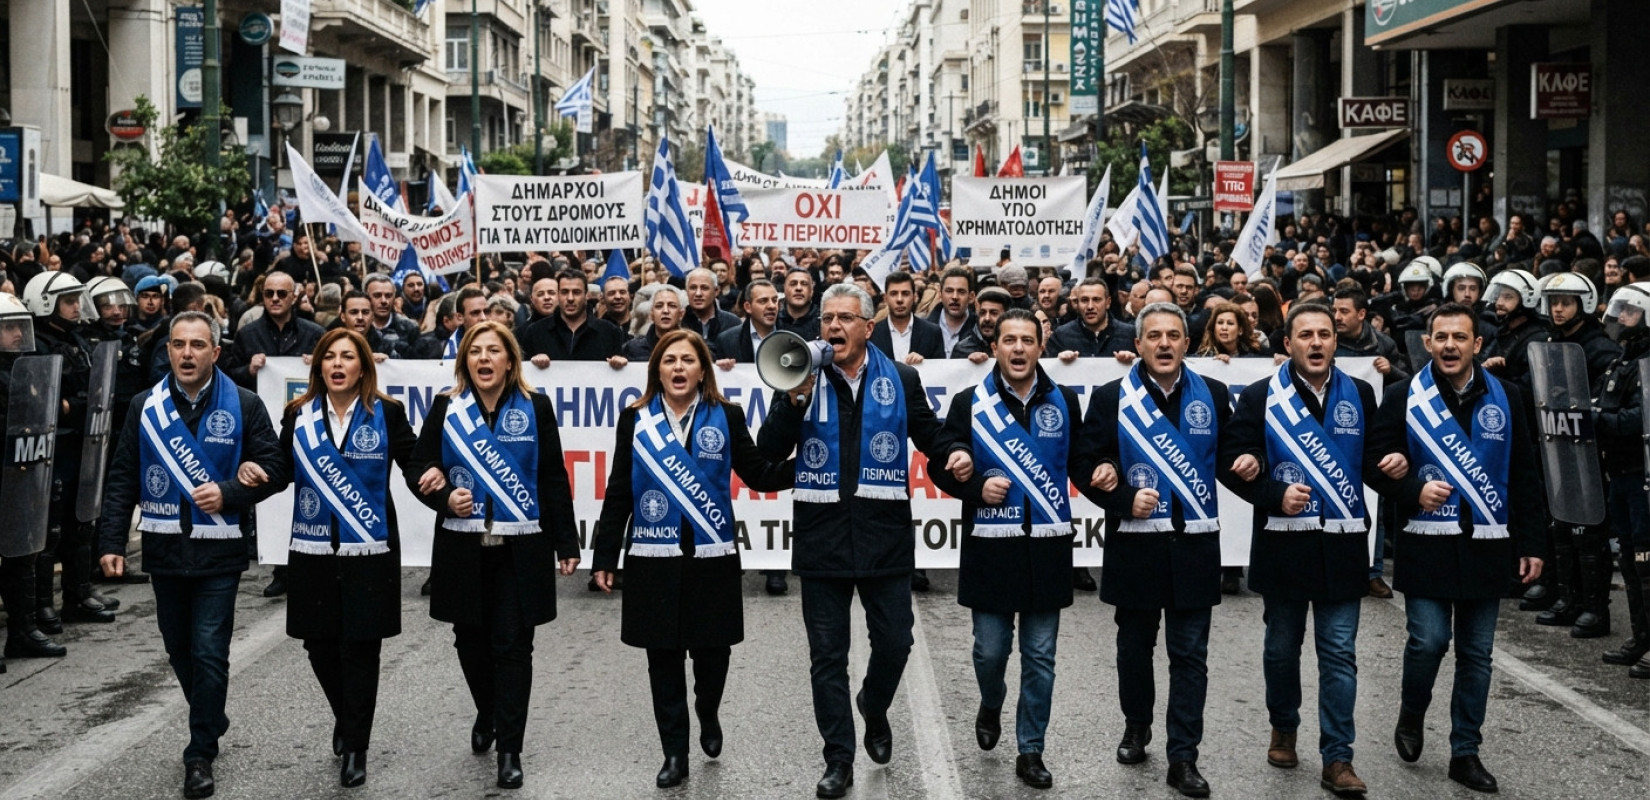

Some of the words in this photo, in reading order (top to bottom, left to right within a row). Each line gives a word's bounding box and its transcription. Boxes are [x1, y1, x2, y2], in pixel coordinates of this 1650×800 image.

[1539, 72, 1589, 92] ΚΑΦΕ
[1345, 102, 1405, 123] ΚΑΦΕ
[511, 182, 604, 199] ΔΗΜΑΡΧΟΙ
[989, 185, 1046, 200] ΔΗΜΟΙ
[492, 204, 542, 221] ΣΤΟΥΣ
[547, 203, 625, 221] ΔΡΟΜΟΥΣ
[795, 193, 841, 219] ΟΧΙ
[1002, 203, 1036, 217] ΥΠΟ
[479, 227, 500, 245] ΓΙΑ
[503, 227, 520, 244] ΤΑ
[525, 224, 640, 245] ΑΥΤΟΔΙΟΙΚΗΤΙΚΑ
[740, 222, 778, 242] ΣΤΙΣ
[783, 223, 882, 244] ΠΕΡΙΚΟΠΕΣ
[956, 220, 1083, 236] ΧΡΗΜΑΤΟΔΟΤΗΣΗ
[1540, 410, 1583, 436] ΜΑΤ
[169, 436, 210, 482] ΔΗΜΑΡ
[1441, 433, 1503, 512] ΔΗΜΑΡΧΟΣ
